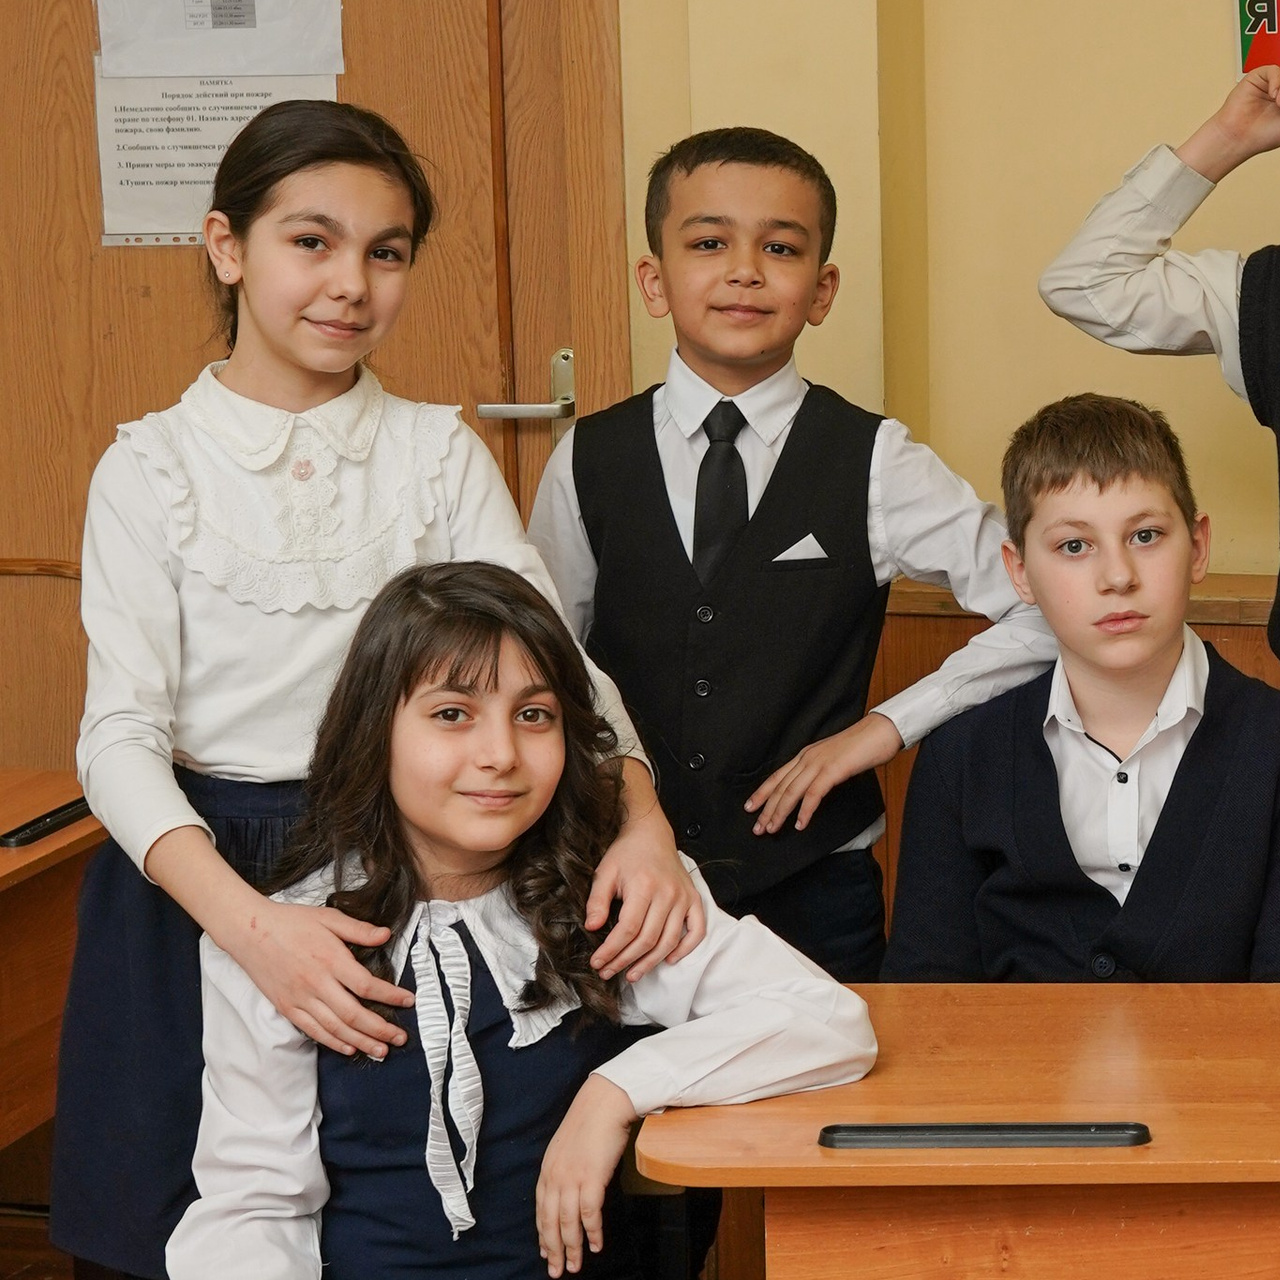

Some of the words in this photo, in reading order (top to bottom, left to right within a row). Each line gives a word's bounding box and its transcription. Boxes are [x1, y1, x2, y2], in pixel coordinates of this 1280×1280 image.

[162, 92, 192, 100] Порядок
[195, 91, 229, 99] действий
[166, 104, 201, 112] сообщить
[114, 116, 139, 124] охране
[152, 114, 184, 124] телефону
[231, 114, 250, 122] адрес
[165, 126, 202, 134] фамилию.
[117, 144, 159, 152] 2.Сообщить
[167, 144, 216, 152] случившемся
[155, 162, 175, 170] меры
[155, 179, 178, 187] пожар
